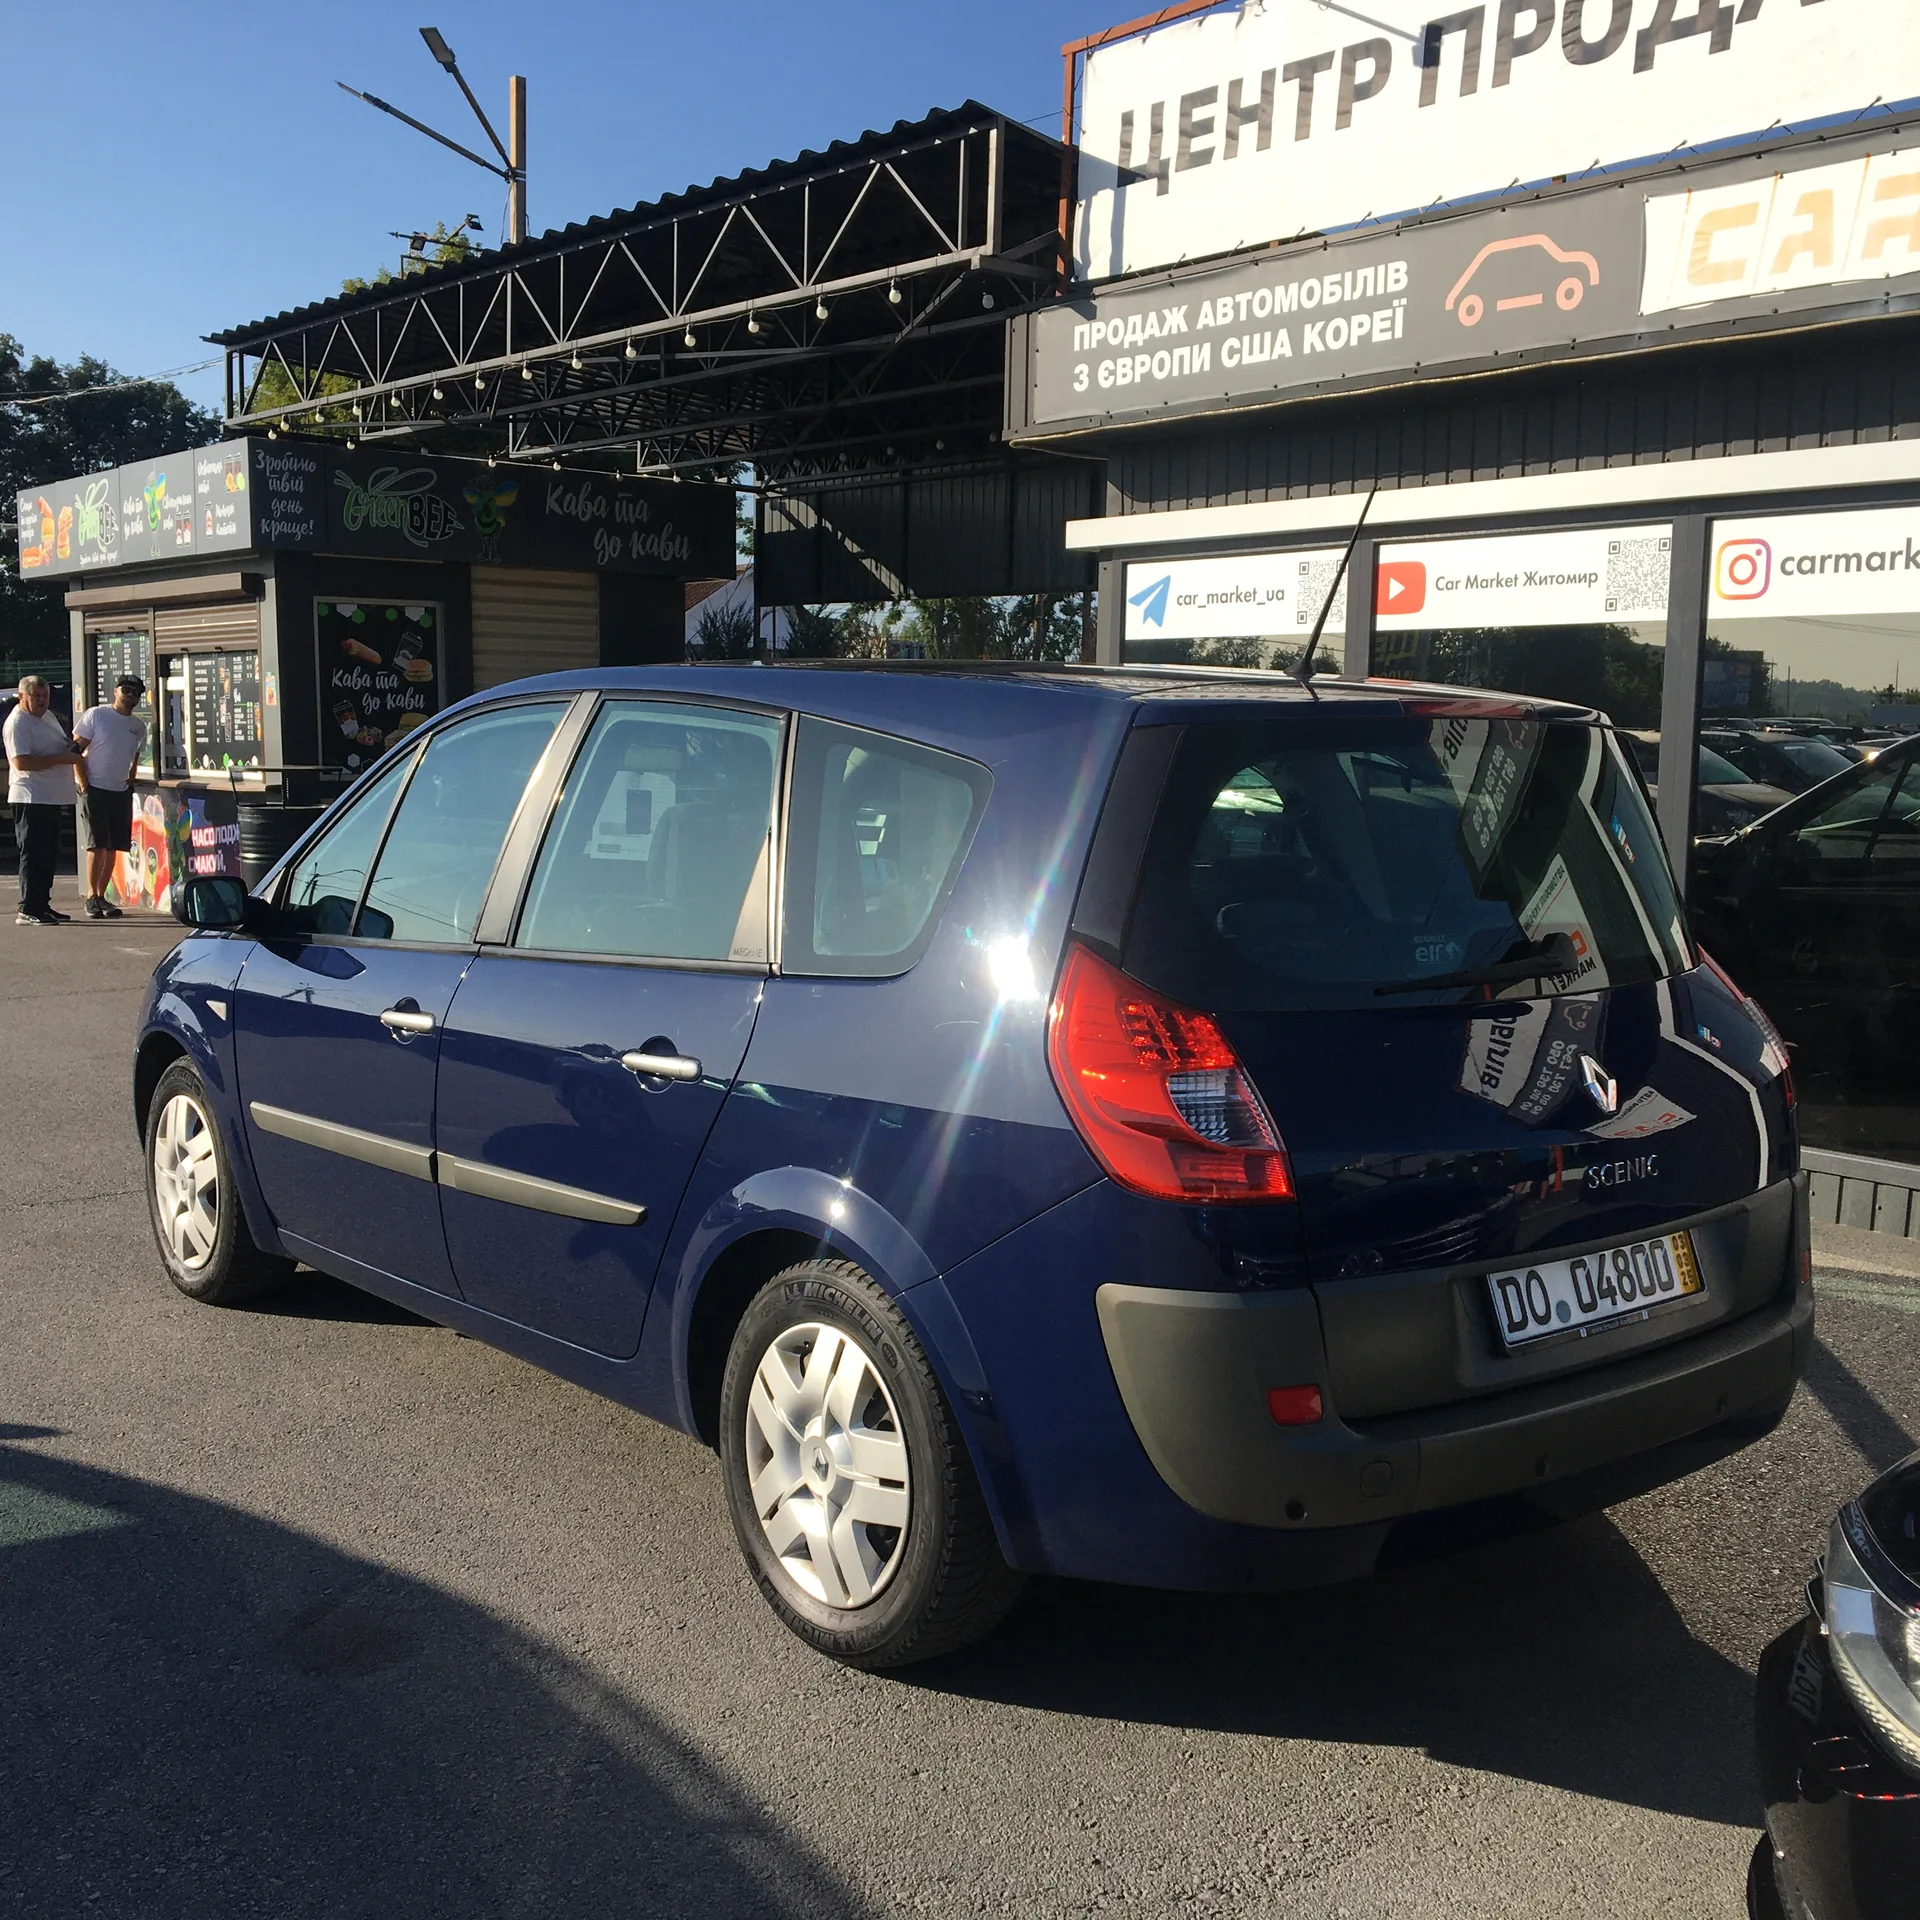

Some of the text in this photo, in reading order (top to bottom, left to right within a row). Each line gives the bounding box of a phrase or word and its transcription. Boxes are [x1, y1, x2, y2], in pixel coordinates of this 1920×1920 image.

[1117, 0, 1823, 197] ЦЕНТР ПРОД
[1073, 260, 1408, 351] ПРОДАЖ АВТОМОБІЛІВ
[1073, 298, 1407, 392] З ЄВРОПИ США КОРЕЇ
[255, 449, 316, 476] Зробимо
[545, 481, 652, 524] Кава та
[593, 522, 691, 565] до кави
[1435, 571, 1598, 591] Car Market Житомир
[1177, 585, 1285, 608] car_market_ua
[332, 666, 400, 690] Кава та
[362, 687, 425, 715] до кави
[1414, 935, 1445, 943] RENAULT
[1415, 943, 1443, 963] elf
[1588, 1154, 1659, 1189] SCENIC
[1671, 1235, 1687, 1251] 03
[1676, 1252, 1691, 1269] 03
[1680, 1269, 1694, 1286] 25
[803, 1281, 883, 1340] MICHELIN
